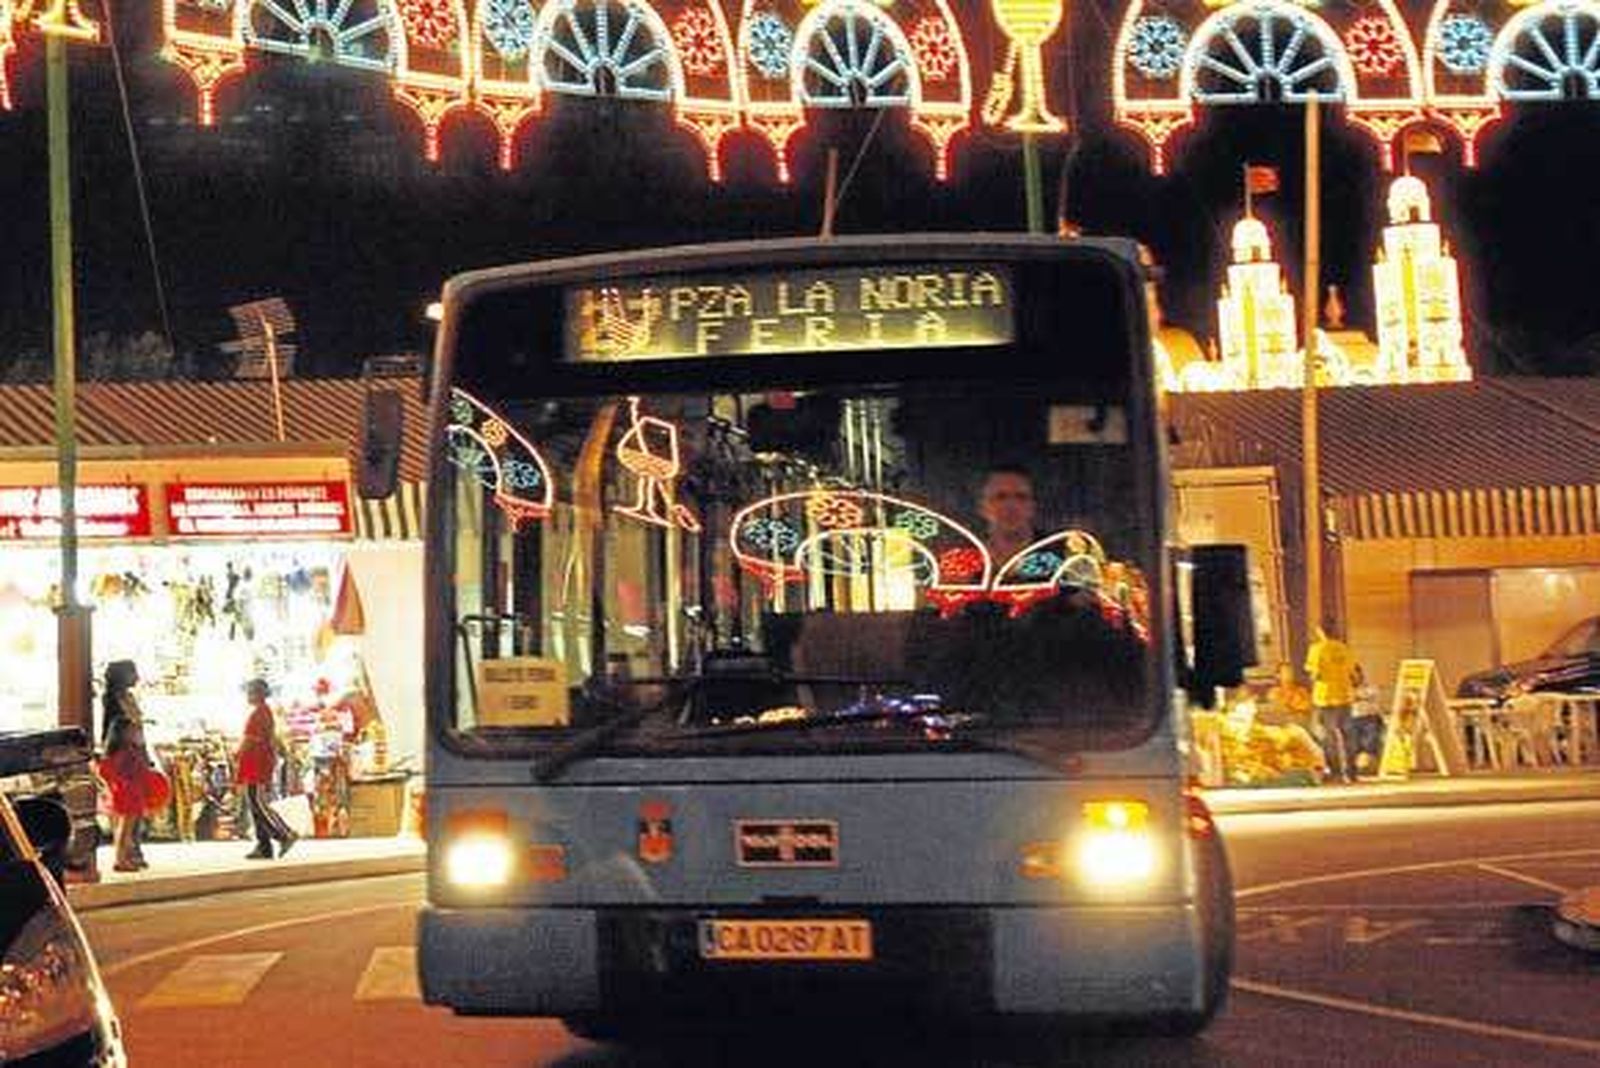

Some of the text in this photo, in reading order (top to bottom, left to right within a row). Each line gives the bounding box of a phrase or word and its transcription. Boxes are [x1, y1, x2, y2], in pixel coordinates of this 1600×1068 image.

[670, 272, 1003, 321] PZA LA NORIA
